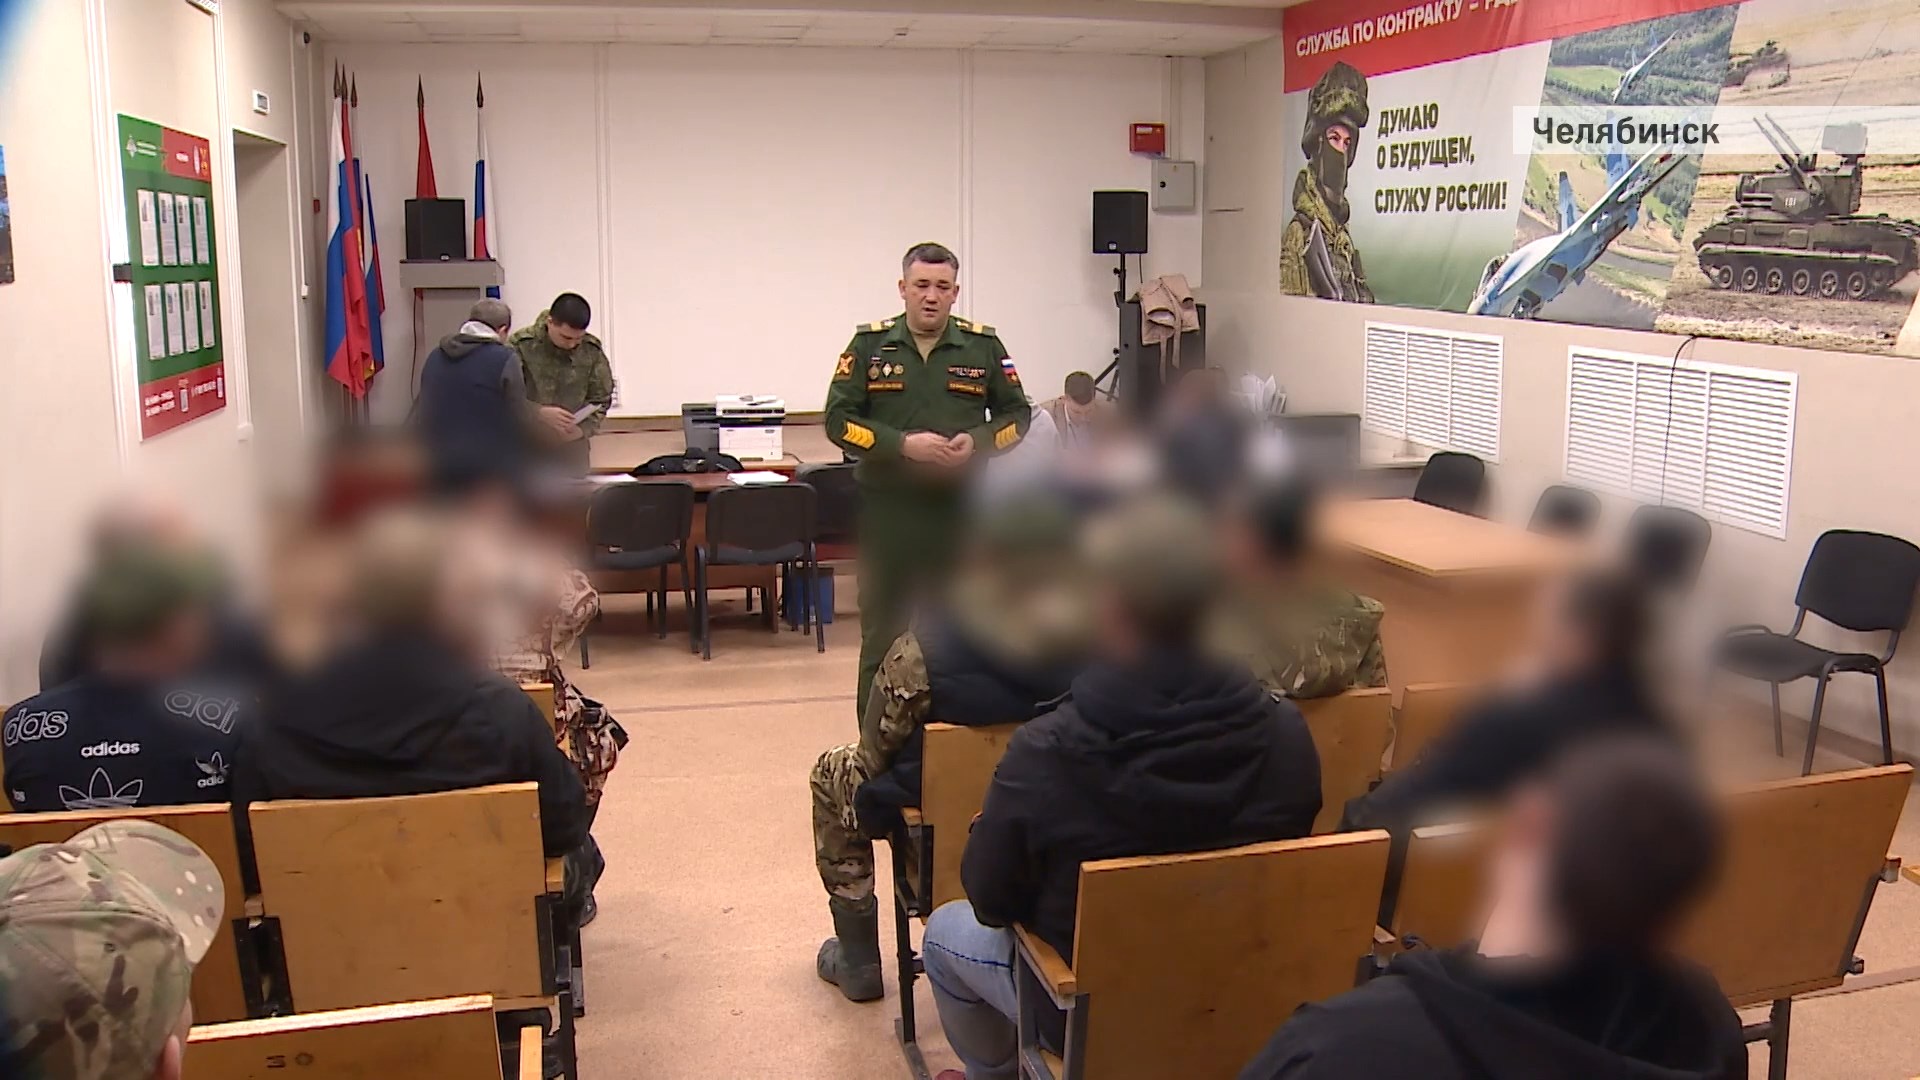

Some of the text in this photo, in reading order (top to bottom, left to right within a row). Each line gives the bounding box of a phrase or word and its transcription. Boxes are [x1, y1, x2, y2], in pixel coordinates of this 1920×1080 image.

[1296, 27, 1351, 56] СЛУЖБА
[1353, 19, 1374, 44] ПО
[1376, 0, 1463, 38] КОНТРАКТУ
[1378, 102, 1439, 139] ДУМАЮ
[1376, 135, 1475, 171] О БУДУЩЕМ,
[1375, 181, 1507, 214] СЛУЖУ РОССИИ!
[80, 741, 140, 758] adidas
